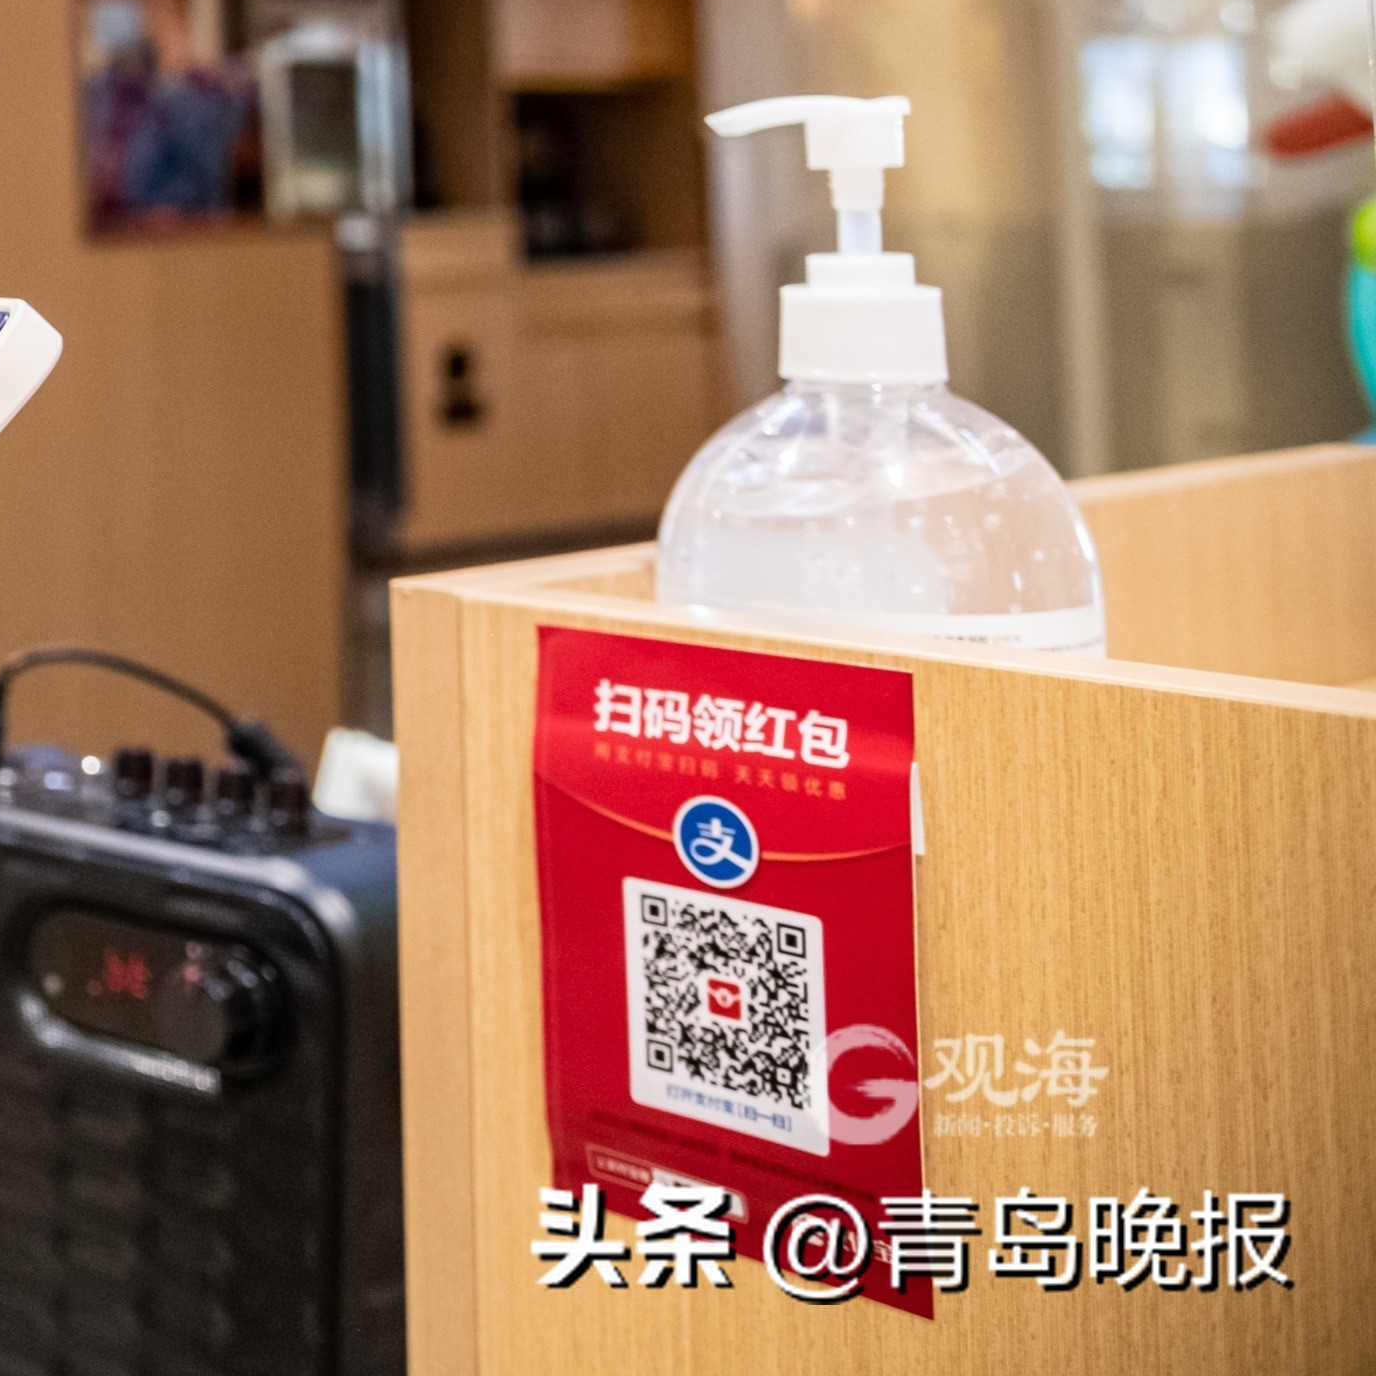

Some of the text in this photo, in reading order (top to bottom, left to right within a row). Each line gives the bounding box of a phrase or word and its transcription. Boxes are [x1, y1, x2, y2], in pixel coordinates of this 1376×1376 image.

[593, 679, 850, 769] 扫码领红包
